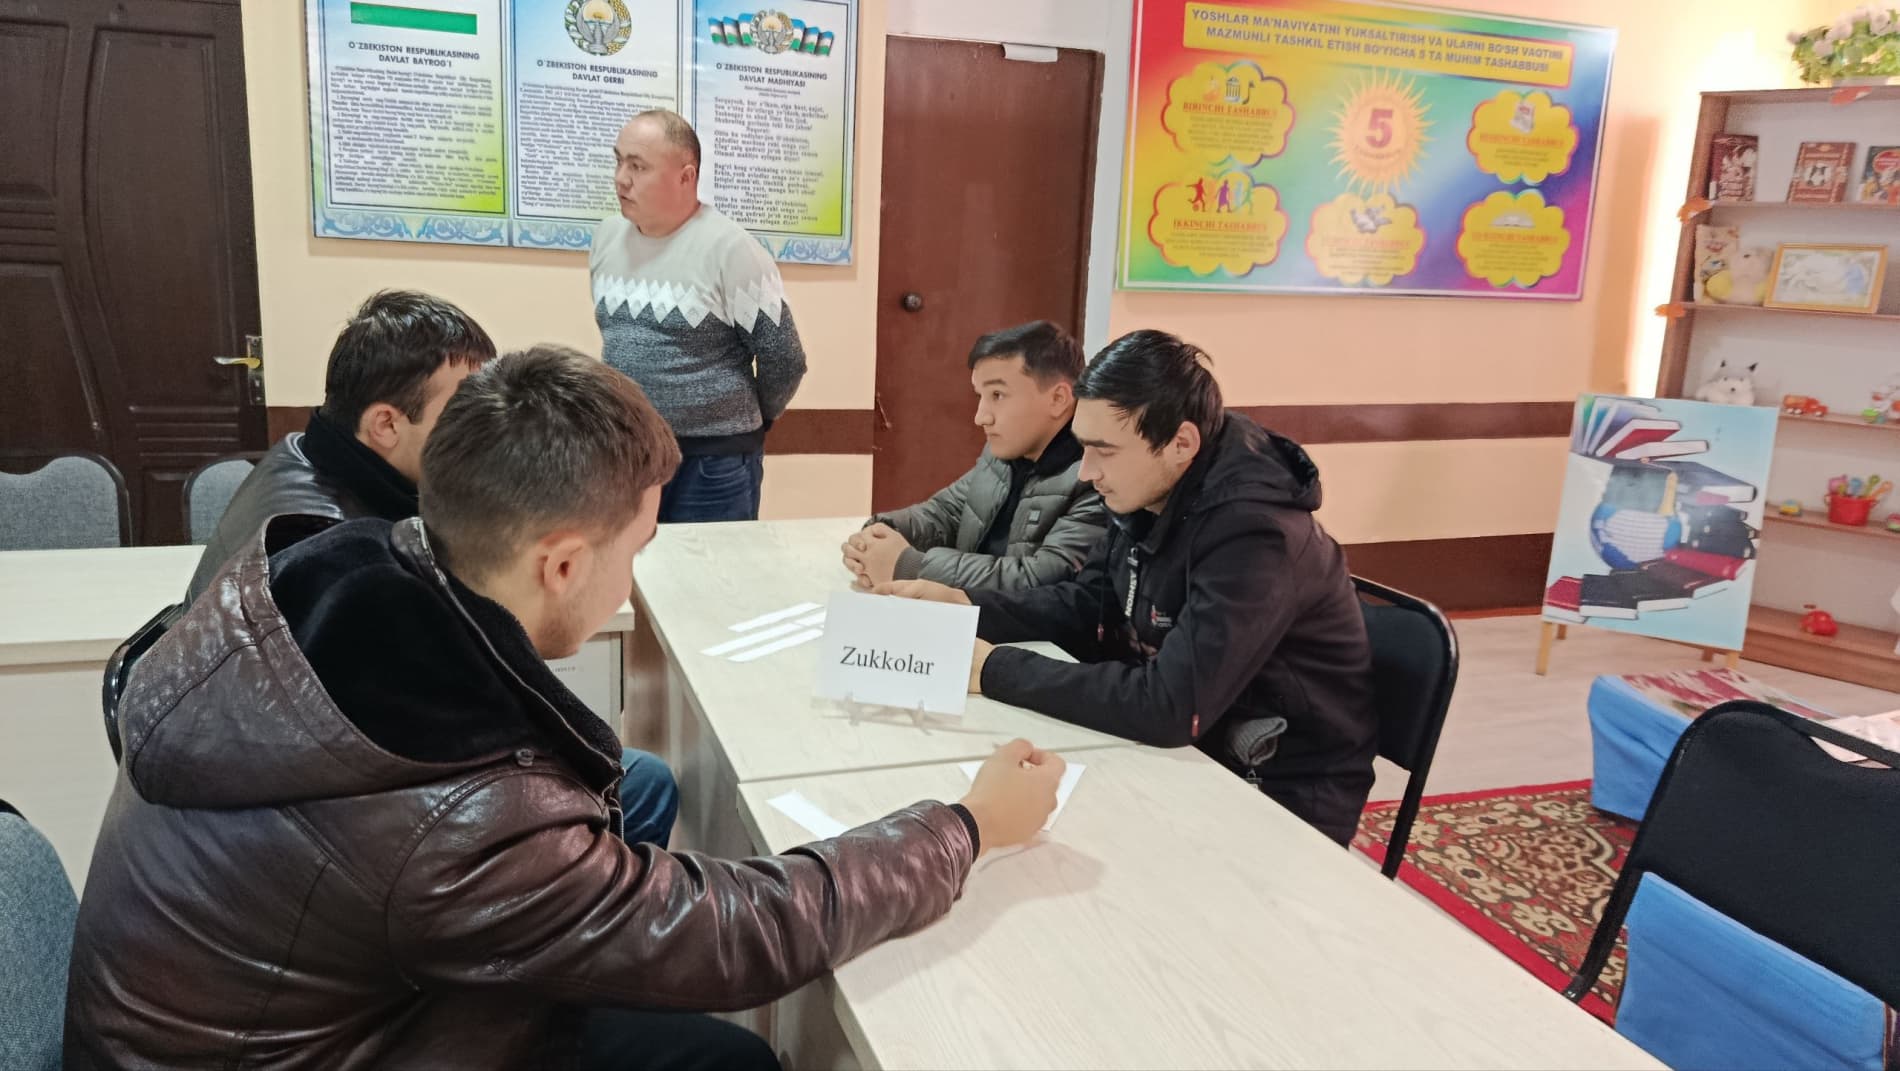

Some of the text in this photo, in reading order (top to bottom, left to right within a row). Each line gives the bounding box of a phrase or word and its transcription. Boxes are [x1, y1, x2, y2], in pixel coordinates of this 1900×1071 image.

[1192, 9, 1248, 25] YOSHLAR
[1253, 16, 1341, 35] MA'NAVIYATINI
[1344, 26, 1425, 44] YUKSALTIRISH
[1428, 35, 1442, 47] VA
[1446, 38, 1485, 52] ULARNI
[405, 46, 480, 60] RESPUBLIKASINING
[1206, 26, 1271, 42] MAZMUNLI
[1275, 34, 1324, 48] TASHKIL
[1327, 39, 1361, 53] ETISH
[1429, 50, 1442, 62] TA
[1446, 53, 1482, 65] MUHIM
[1485, 57, 1549, 72] TASHABBUSI
[378, 54, 409, 64] DAVLAT
[589, 64, 658, 78] RESPUBLIKASINING
[764, 67, 828, 81] RESPUBLIKASINING
[572, 73, 624, 84] DAVLAT GERBI
[738, 74, 806, 87] DAVLAT MADHIYASI
[1366, 108, 1393, 148] 5
[839, 645, 935, 675] Zukkolar
